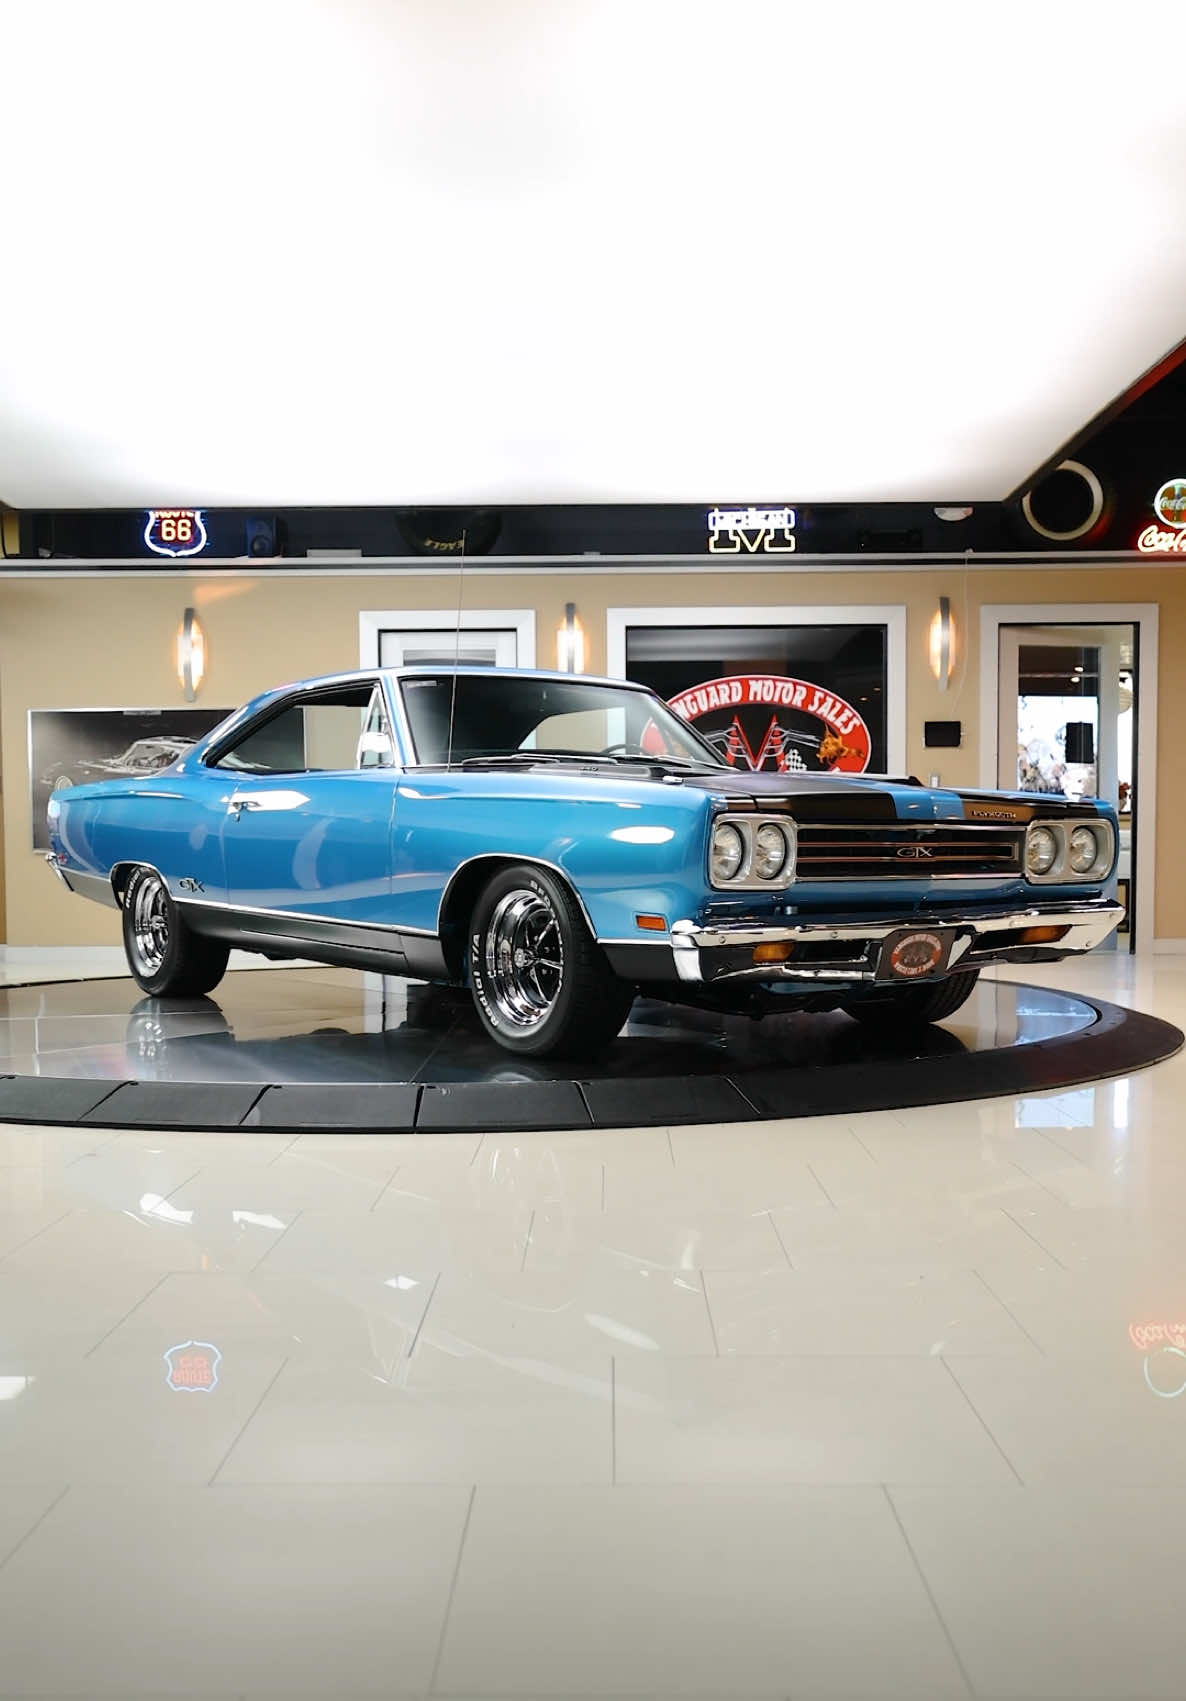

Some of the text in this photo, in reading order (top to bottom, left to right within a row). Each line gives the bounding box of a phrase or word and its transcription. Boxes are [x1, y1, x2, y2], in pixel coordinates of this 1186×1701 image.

[162, 519, 191, 541] 66
[748, 680, 808, 707] MOTOR
[808, 691, 861, 735] SALES
[897, 846, 932, 858] GTX
[472, 934, 480, 963] T/A
